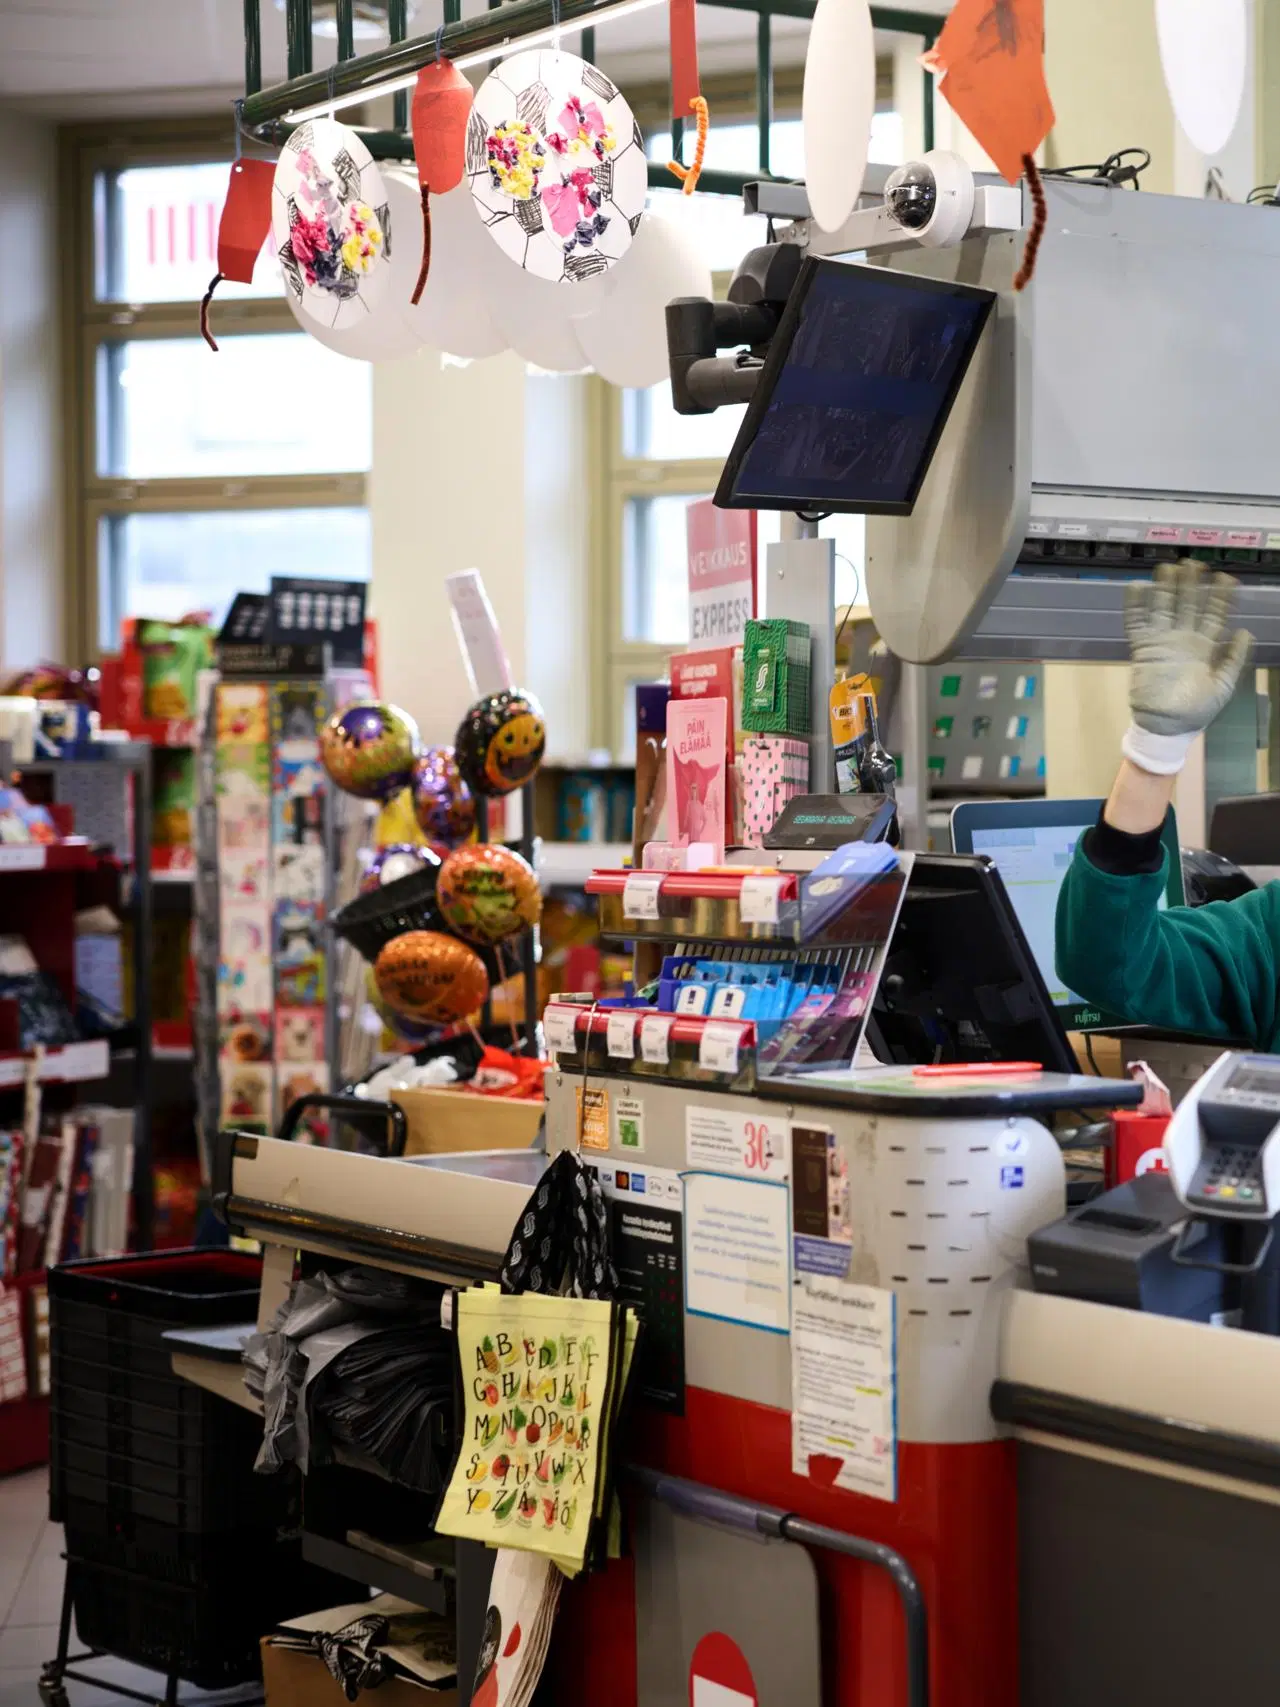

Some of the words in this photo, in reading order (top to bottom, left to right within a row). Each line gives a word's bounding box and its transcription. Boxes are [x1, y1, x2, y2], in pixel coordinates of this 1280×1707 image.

[692, 596, 748, 639] EXPRESS
[1075, 1008, 1101, 1026] FUJITSU
[476, 1346, 488, 1371] A
[496, 1332, 513, 1357] B
[537, 1346, 551, 1369] D
[566, 1341, 577, 1366] E
[586, 1353, 599, 1380] F
[473, 1376, 486, 1402] G
[502, 1372, 515, 1398] H
[544, 1377, 558, 1403] J
[562, 1373, 576, 1398] K
[474, 1414, 490, 1440] M
[501, 1409, 514, 1433] N
[531, 1405, 547, 1428] O
[466, 1453, 480, 1480] S
[516, 1464, 529, 1484] U
[534, 1450, 546, 1475] V
[552, 1452, 567, 1475] W
[573, 1458, 588, 1485] X
[465, 1488, 480, 1515] Y
[491, 1489, 508, 1512] Z
